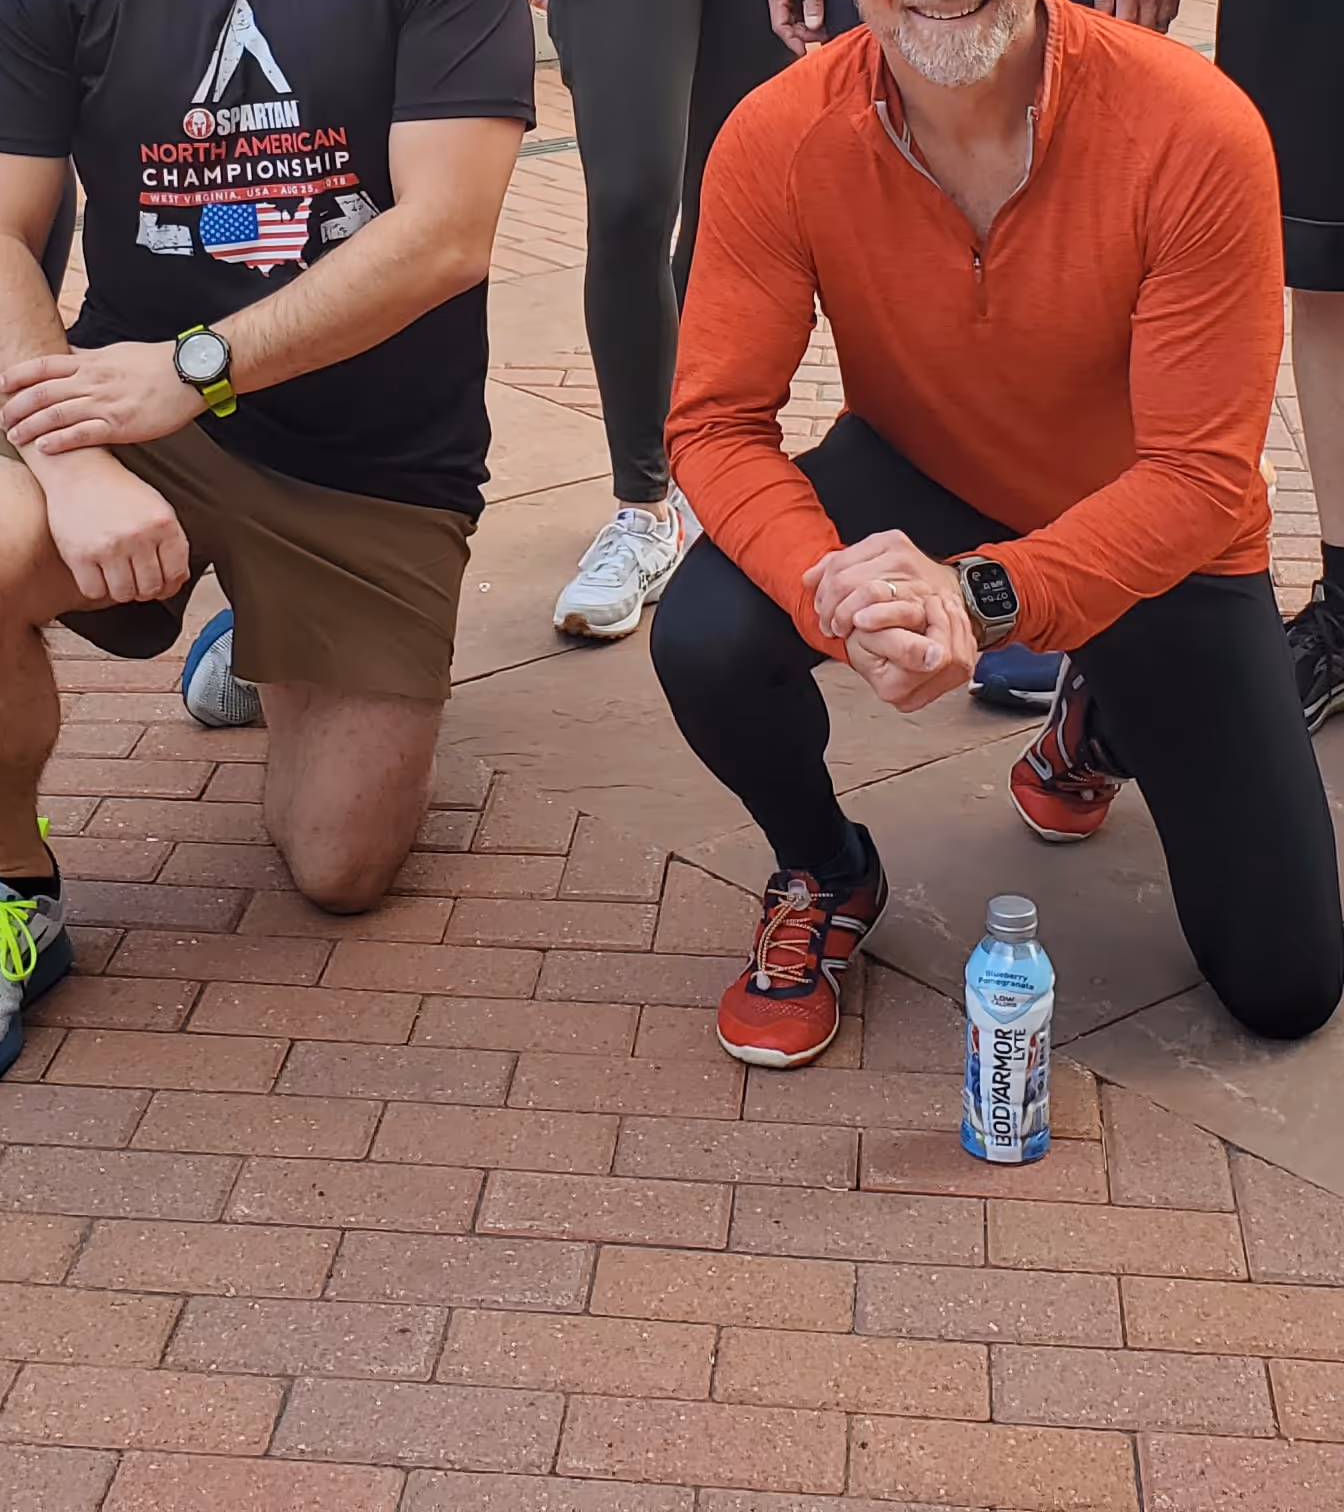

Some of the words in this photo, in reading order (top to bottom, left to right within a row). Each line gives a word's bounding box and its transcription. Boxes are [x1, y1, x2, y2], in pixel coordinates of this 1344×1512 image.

[216, 100, 300, 136] SPARTAN
[140, 140, 227, 164] NORTH
[234, 127, 348, 158] AMERICAN
[142, 151, 350, 187] CHAMPIONSHIP
[150, 193, 179, 204] WEST
[246, 186, 269, 198] USA
[280, 185, 298, 196] AUG
[323, 177, 347, 187] 018
[978, 977, 1035, 990] Pomegranate
[985, 970, 1028, 983] Blueberry
[993, 994, 1016, 1002] LOW
[1014, 1028, 1026, 1060] LYTE
[991, 1028, 1013, 1147] BODYARMOR
